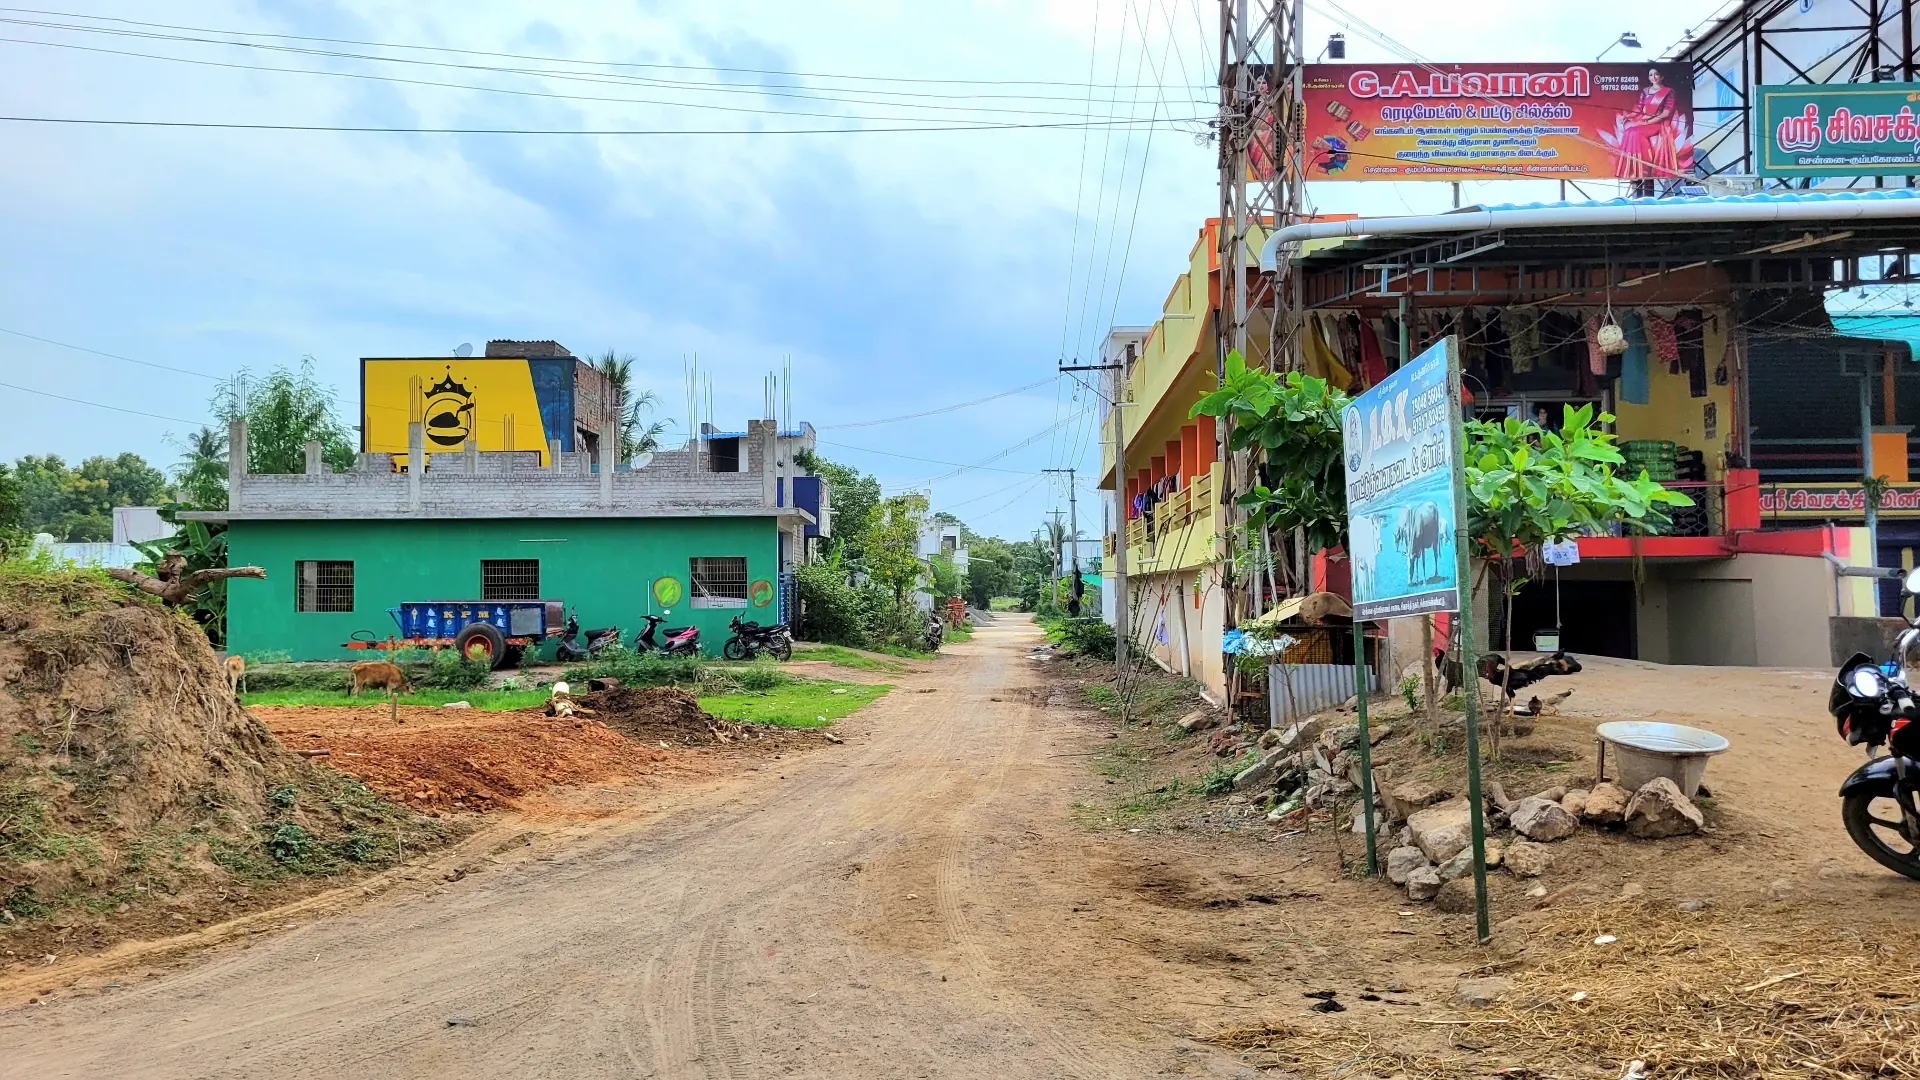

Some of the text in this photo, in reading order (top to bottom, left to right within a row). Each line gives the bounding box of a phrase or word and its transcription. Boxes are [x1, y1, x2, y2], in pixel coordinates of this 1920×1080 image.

[1348, 66, 1590, 97] G.A.பவானி
[1381, 103, 1462, 123] ரெடிமேட்ஸ்
[1465, 104, 1477, 119] &
[1480, 105, 1512, 122] பட்டு
